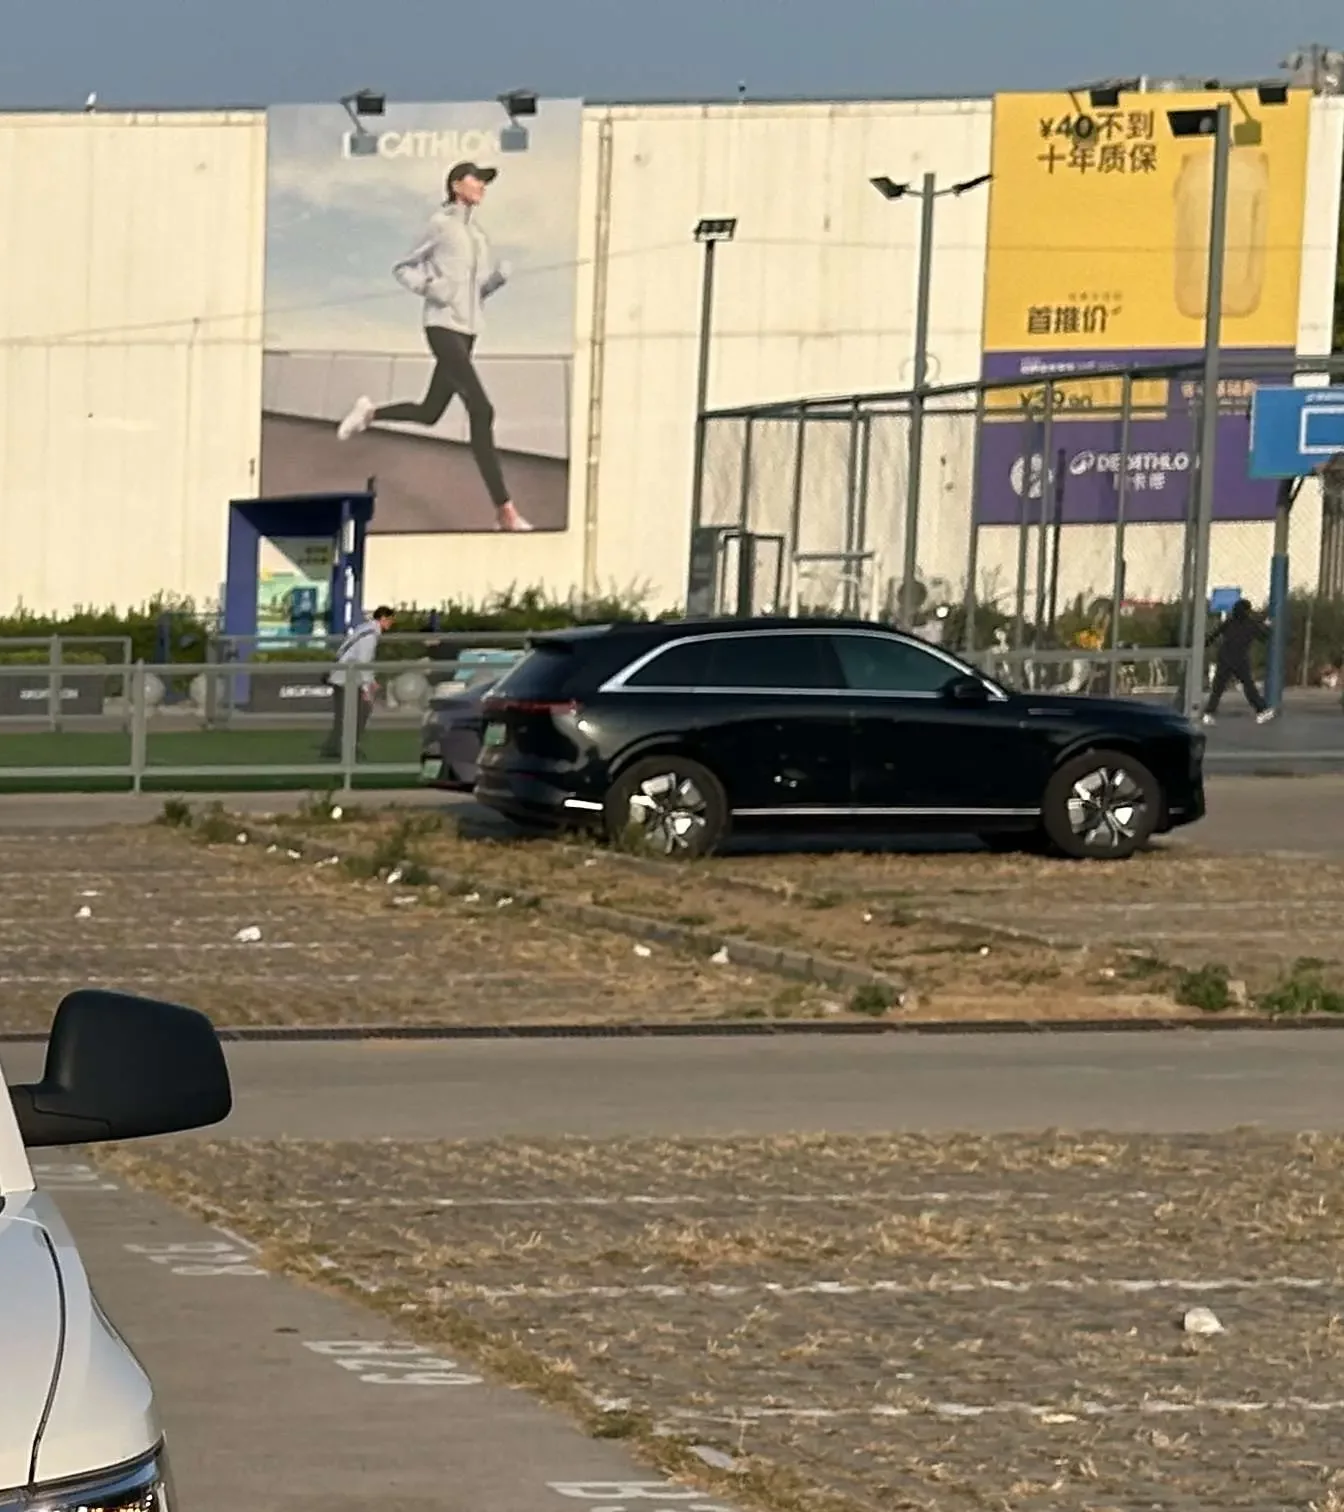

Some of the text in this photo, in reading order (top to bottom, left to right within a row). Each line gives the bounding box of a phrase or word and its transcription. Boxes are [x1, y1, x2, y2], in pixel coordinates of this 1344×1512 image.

[342, 130, 500, 160] CATHLO
[1037, 144, 1157, 175] 十年质保
[1026, 305, 1108, 335] 首推价
[1097, 452, 1200, 472] DEATHLO
[302, 1341, 484, 1385] B29
